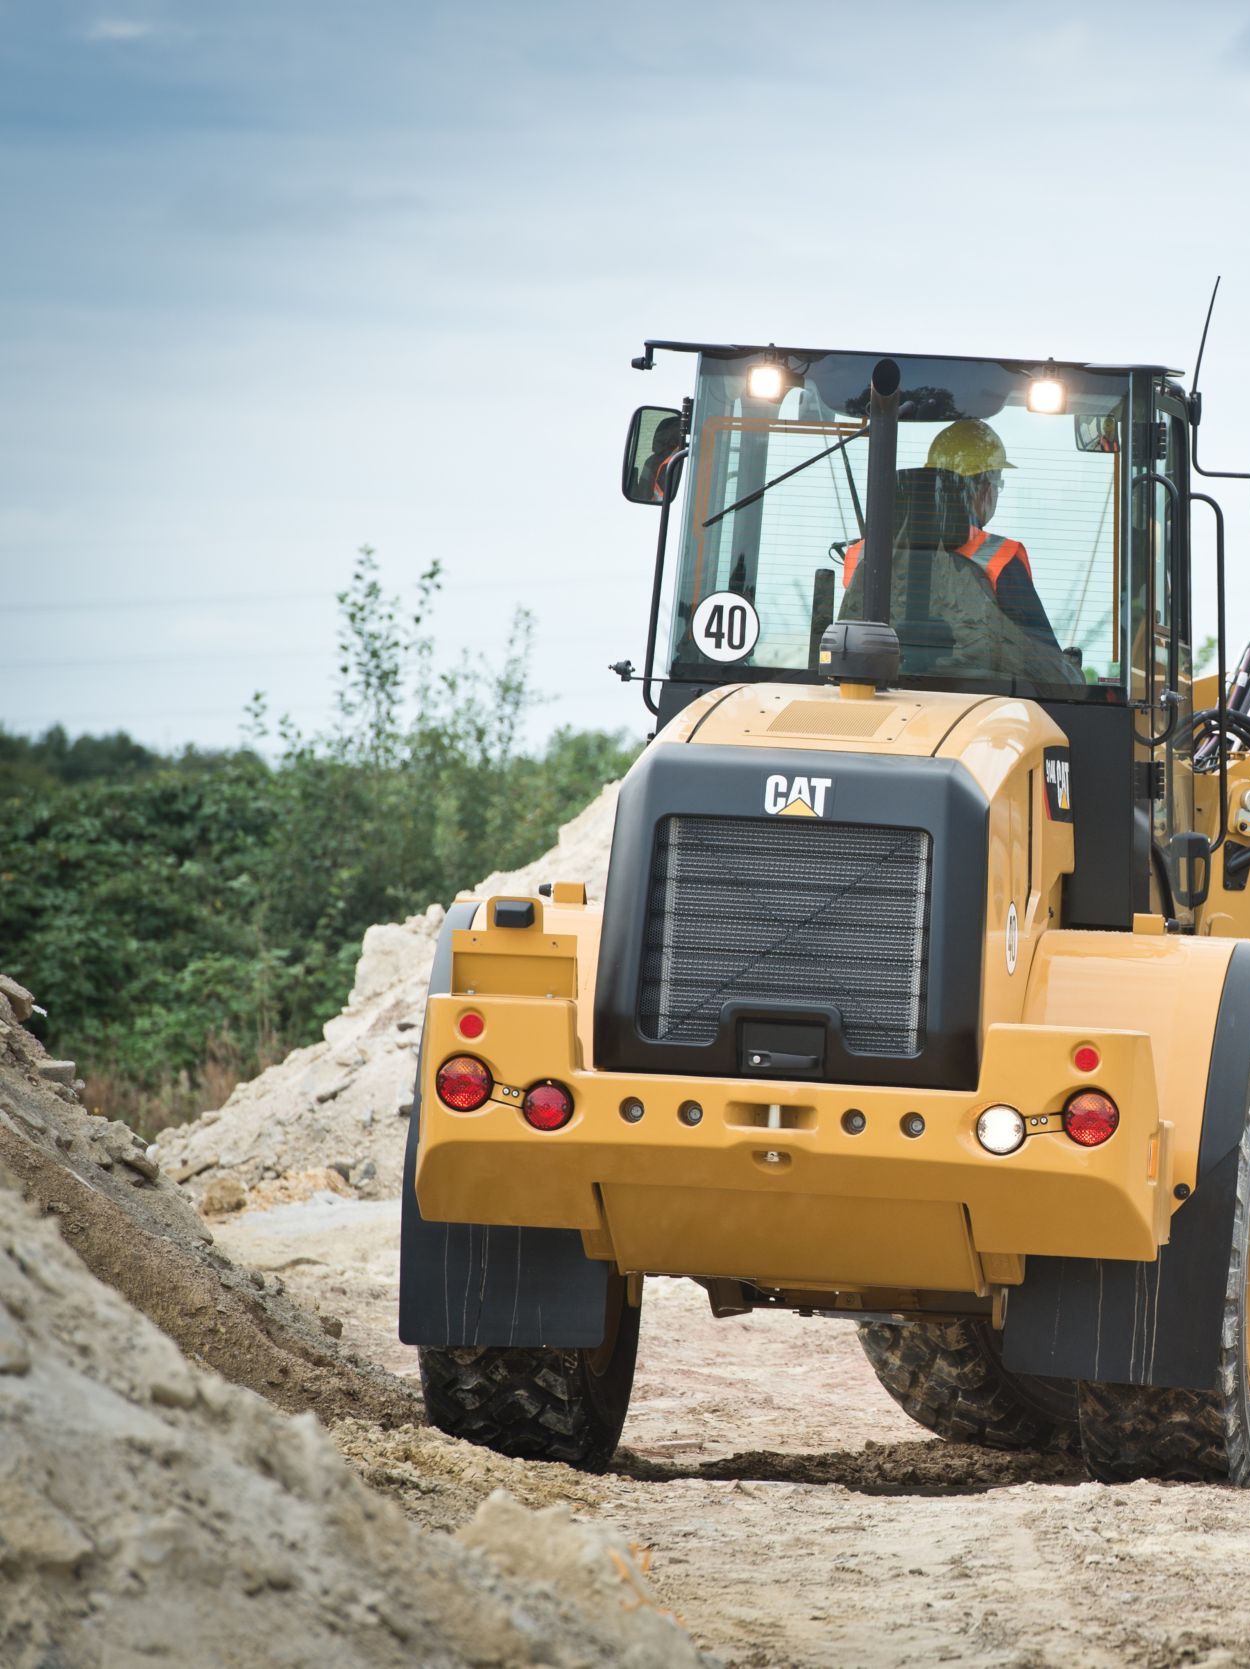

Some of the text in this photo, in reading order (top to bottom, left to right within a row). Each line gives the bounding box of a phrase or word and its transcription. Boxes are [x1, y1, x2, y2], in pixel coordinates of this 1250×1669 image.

[704, 604, 747, 650] 40
[764, 774, 832, 817] CAT
[1056, 759, 1070, 809] CAT
